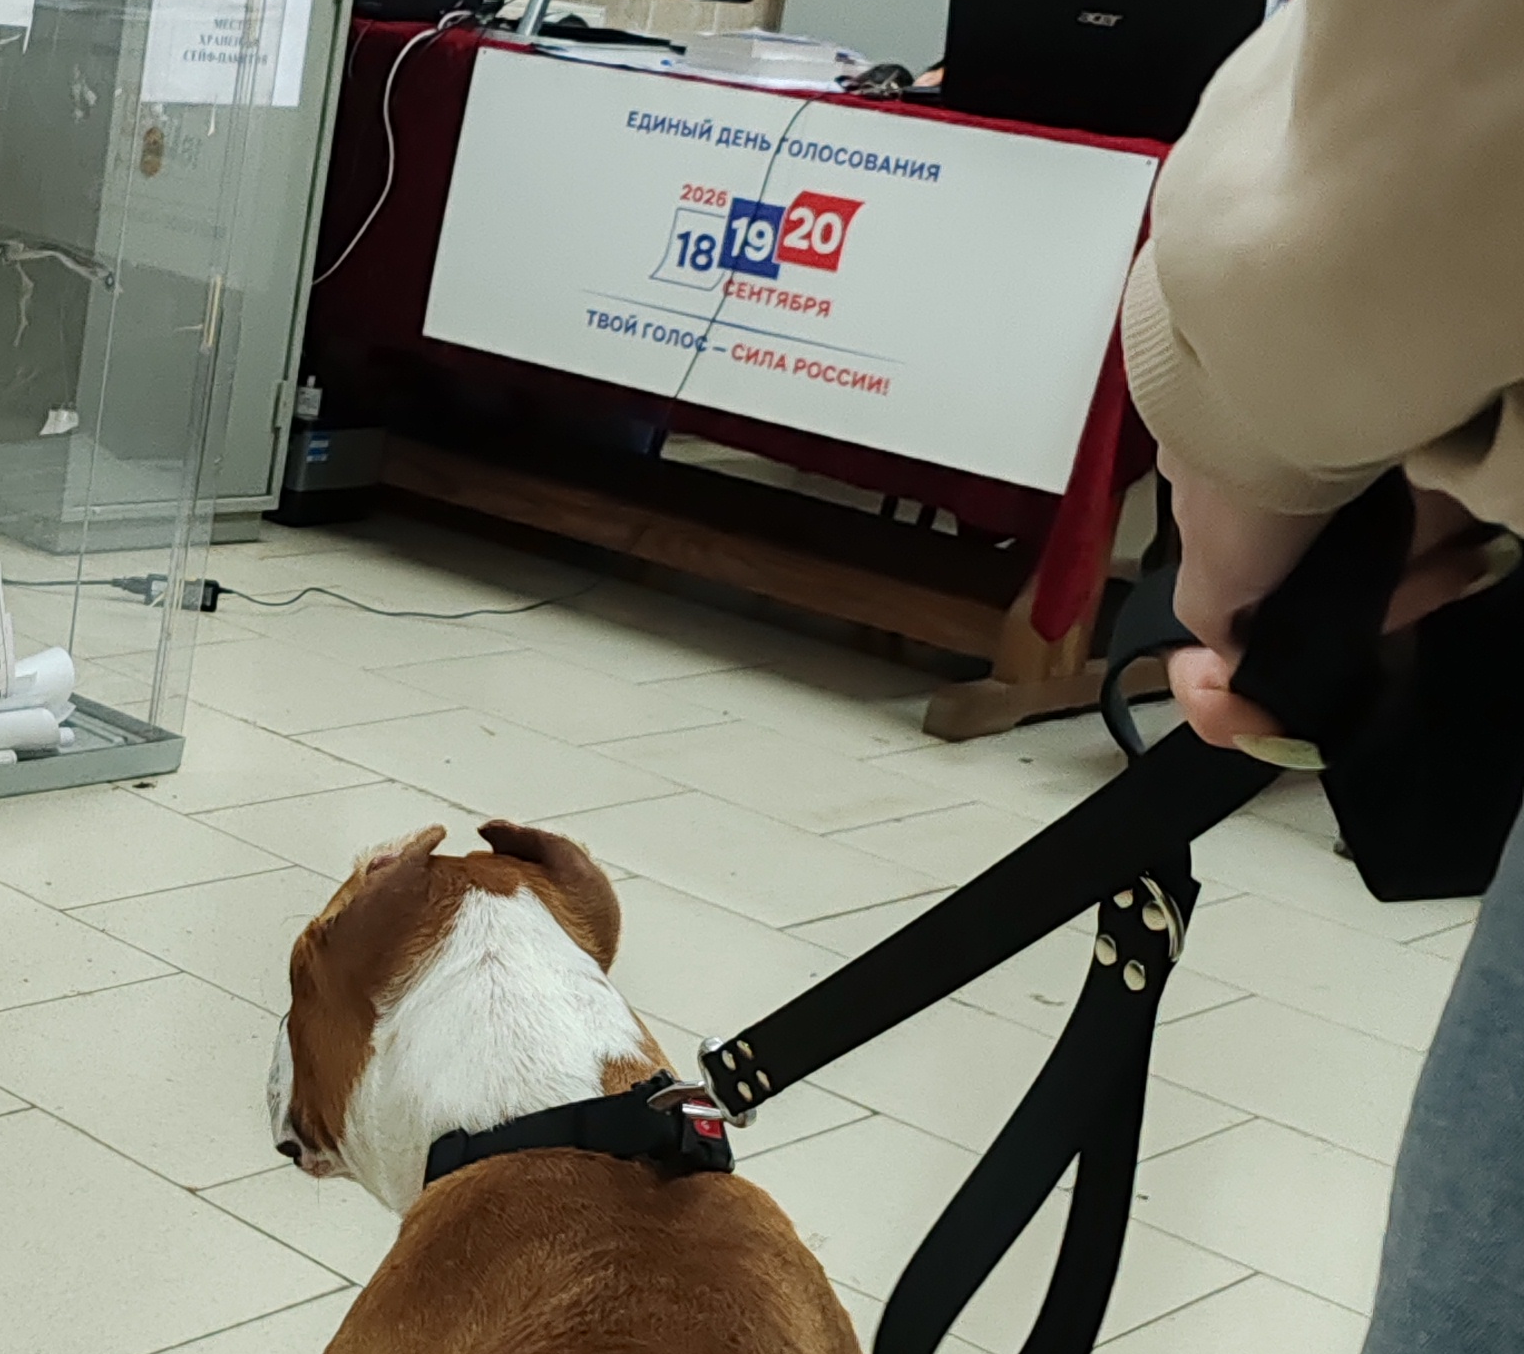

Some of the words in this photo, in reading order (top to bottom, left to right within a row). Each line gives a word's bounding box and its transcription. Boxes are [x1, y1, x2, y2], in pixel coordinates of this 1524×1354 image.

[1077, 11, 1124, 26] acer
[626, 110, 712, 143] ЕДИНЫЙ
[715, 126, 772, 153] ДЕНЬ
[776, 136, 941, 183] ГОЛОСОВАНИЯ
[680, 183, 728, 208] 2026
[676, 230, 717, 272] 18
[730, 216, 775, 263] 19
[783, 207, 844, 256] 20
[724, 279, 833, 317] СЕНТЯБРЯ
[586, 307, 636, 336] ТВОЙ
[642, 323, 708, 353] ГОЛОС
[731, 343, 788, 372] СИЛА
[792, 357, 892, 396] РОССИИ!
